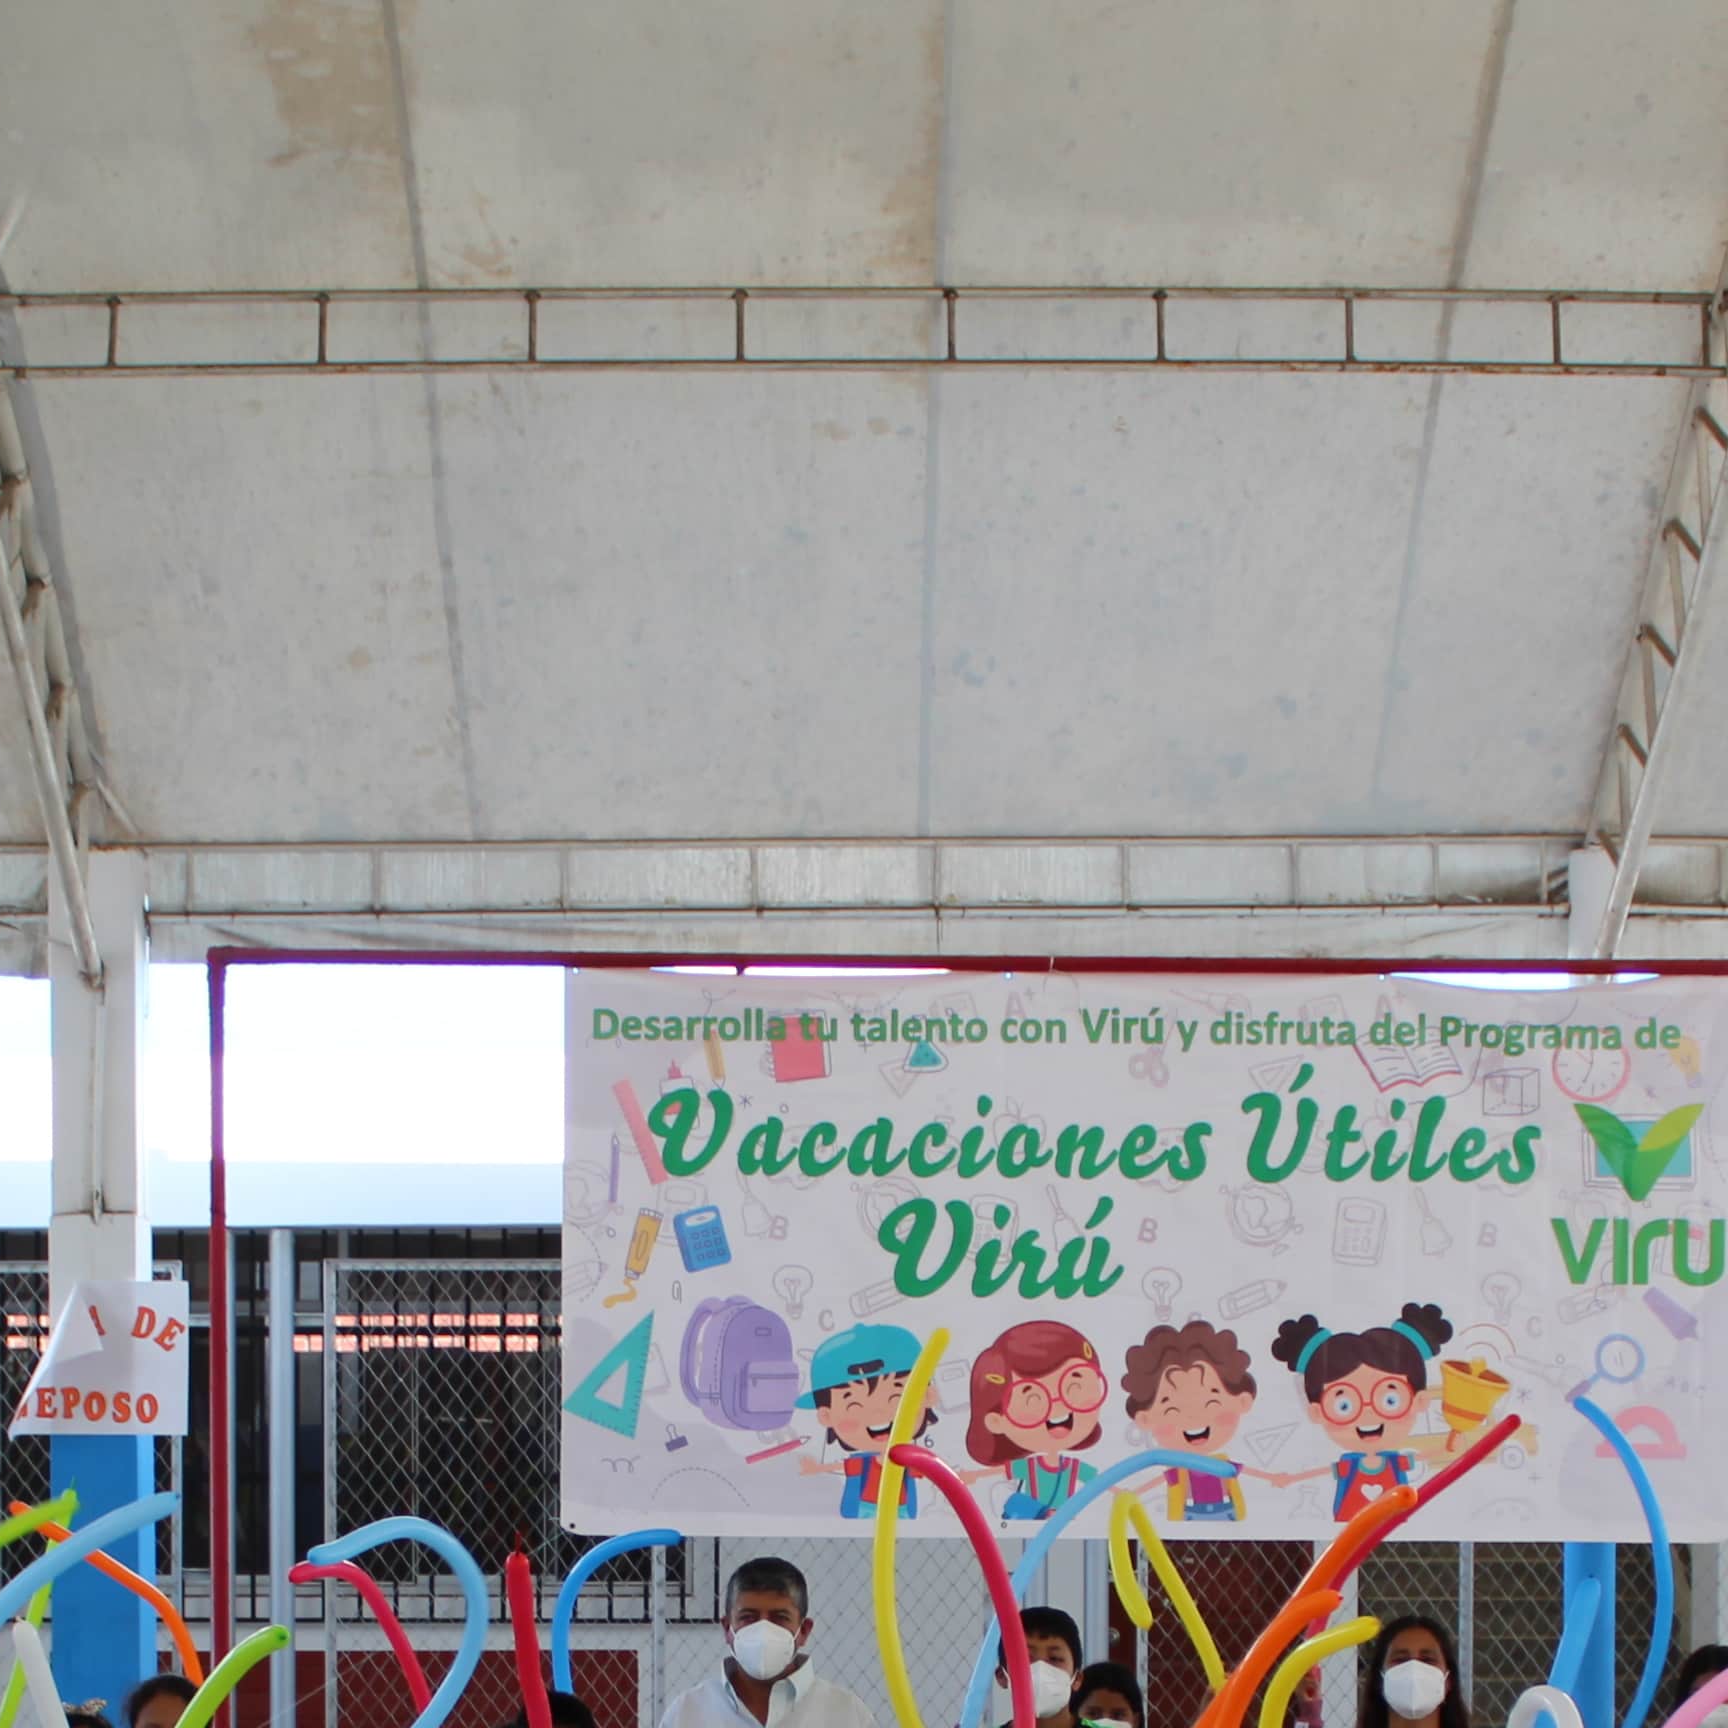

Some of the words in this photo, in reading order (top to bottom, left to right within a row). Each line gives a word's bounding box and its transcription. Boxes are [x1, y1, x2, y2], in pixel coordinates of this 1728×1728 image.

[592, 1008, 787, 1041] Desarrolla
[799, 1012, 838, 1042] tu
[850, 1009, 988, 1043] talento
[1000, 1018, 1067, 1043] con
[1080, 1007, 1164, 1044] Virú
[1176, 1018, 1199, 1052] y
[1210, 1010, 1356, 1046] disfruta
[1369, 1013, 1426, 1046] del
[1440, 1016, 1622, 1056] Programa
[1634, 1016, 1681, 1049] de
[647, 1087, 1213, 1181] Vacaciones
[1241, 1062, 1542, 1185] Útiles
[878, 1196, 1125, 1300] Virú
[131, 1305, 186, 1352] DE
